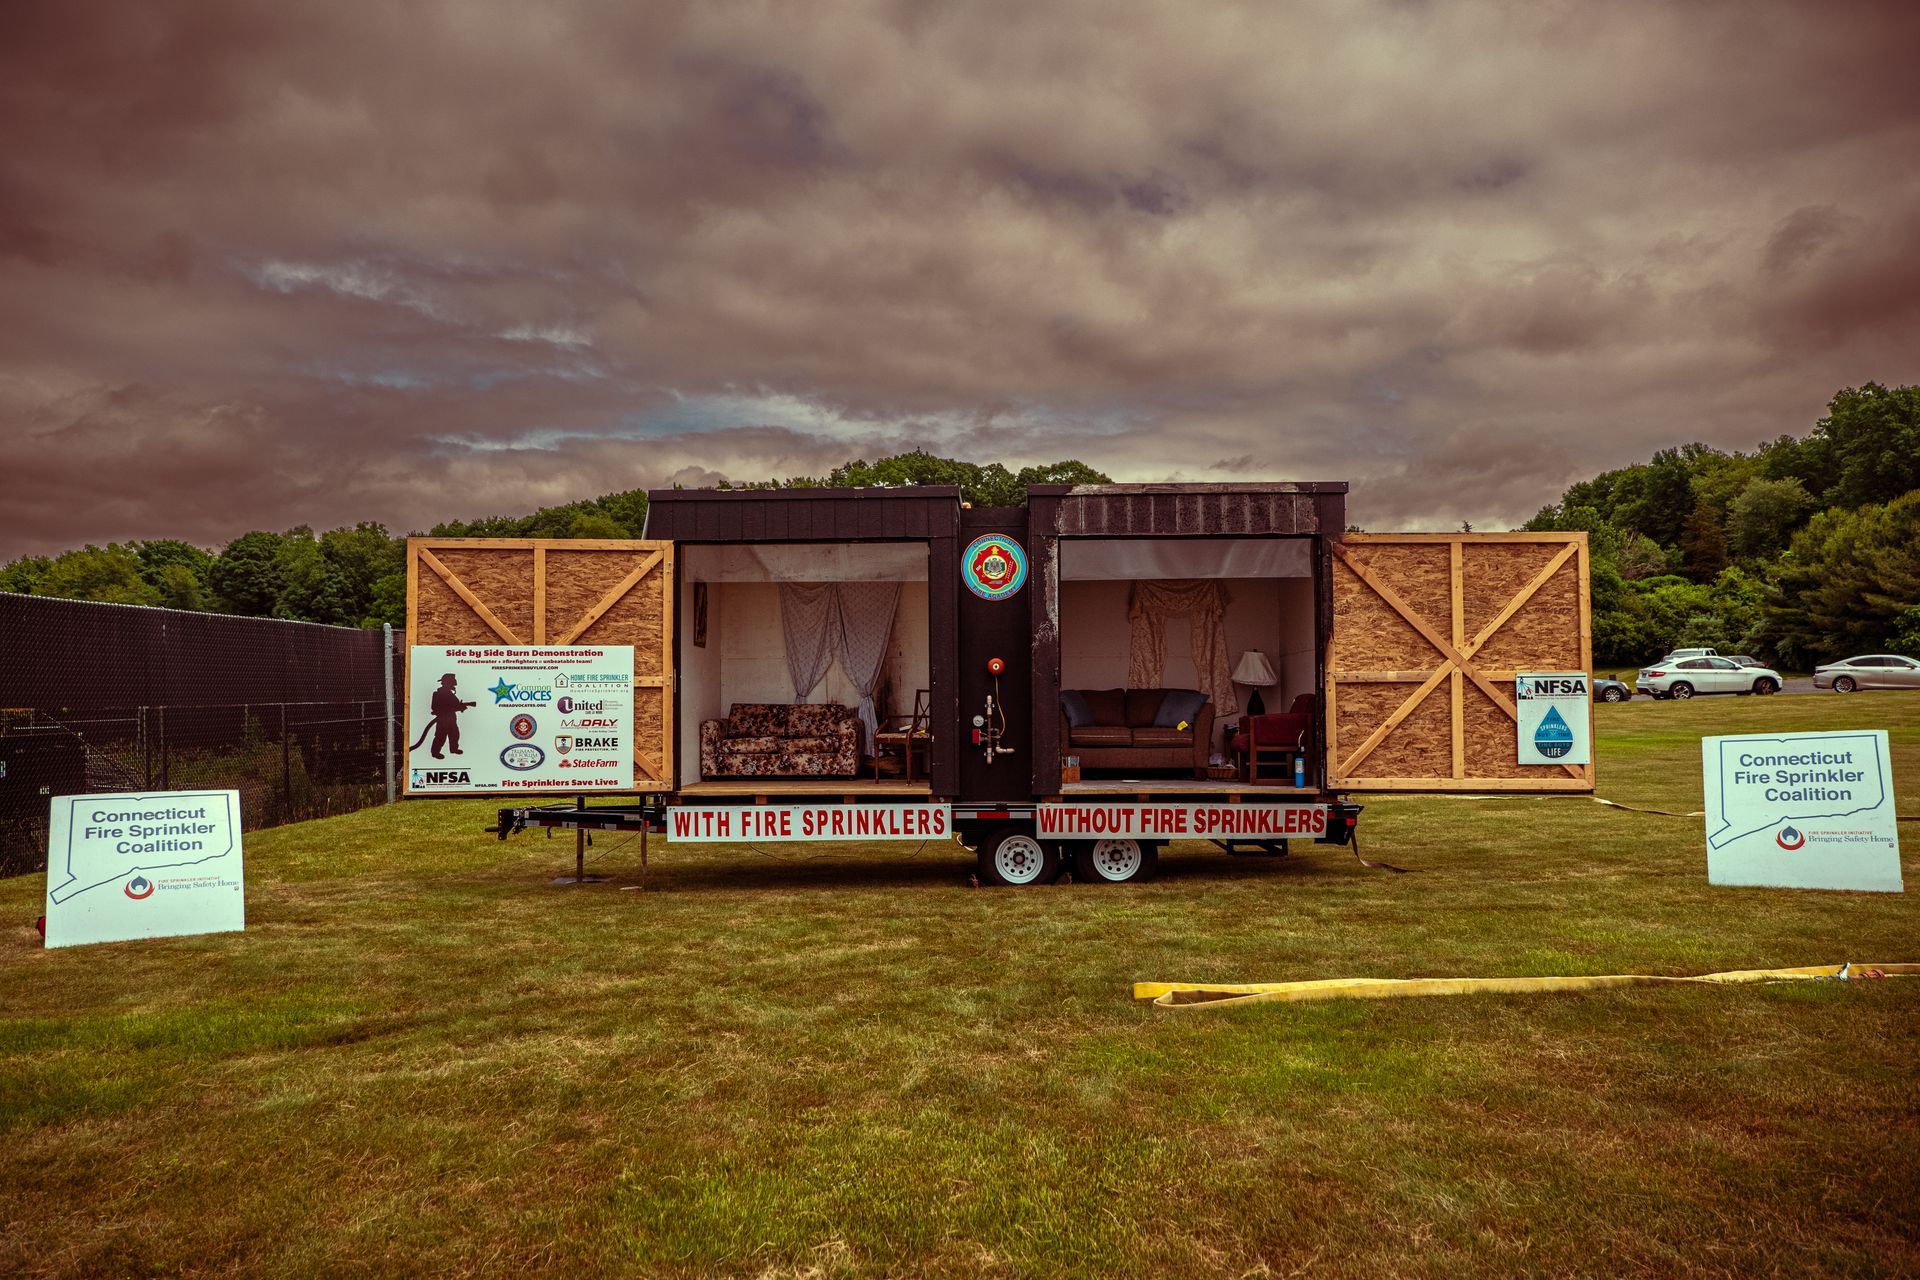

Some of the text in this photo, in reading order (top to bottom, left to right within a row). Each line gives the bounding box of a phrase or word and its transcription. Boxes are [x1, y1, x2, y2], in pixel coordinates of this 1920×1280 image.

[446, 649, 467, 657] Side
[469, 649, 481, 658] by
[484, 649, 504, 657] Side
[532, 649, 603, 657] Demonstration
[1534, 680, 1587, 694] NFSA
[511, 690, 552, 701] VOICES
[557, 697, 603, 713] United
[575, 738, 618, 747] BRAKE
[1547, 747, 1561, 756] LIFE
[1739, 751, 1853, 767] Connecticut
[426, 771, 470, 783] NFSA
[521, 779, 569, 788] Sprinklers
[1735, 769, 1864, 786] Fire Sprinkler
[1765, 787, 1852, 802] Coalition
[91, 807, 206, 823] Connecticut
[674, 808, 945, 837] WITH FIRE SPRINKLERS
[1039, 808, 1325, 834] WITHOUT FIRE SPRINKLERS
[85, 823, 216, 839] Fire Sprinkler
[116, 839, 203, 854] Coalition
[1808, 835, 1843, 843] Bringing
[1844, 835, 1869, 843] Safety
